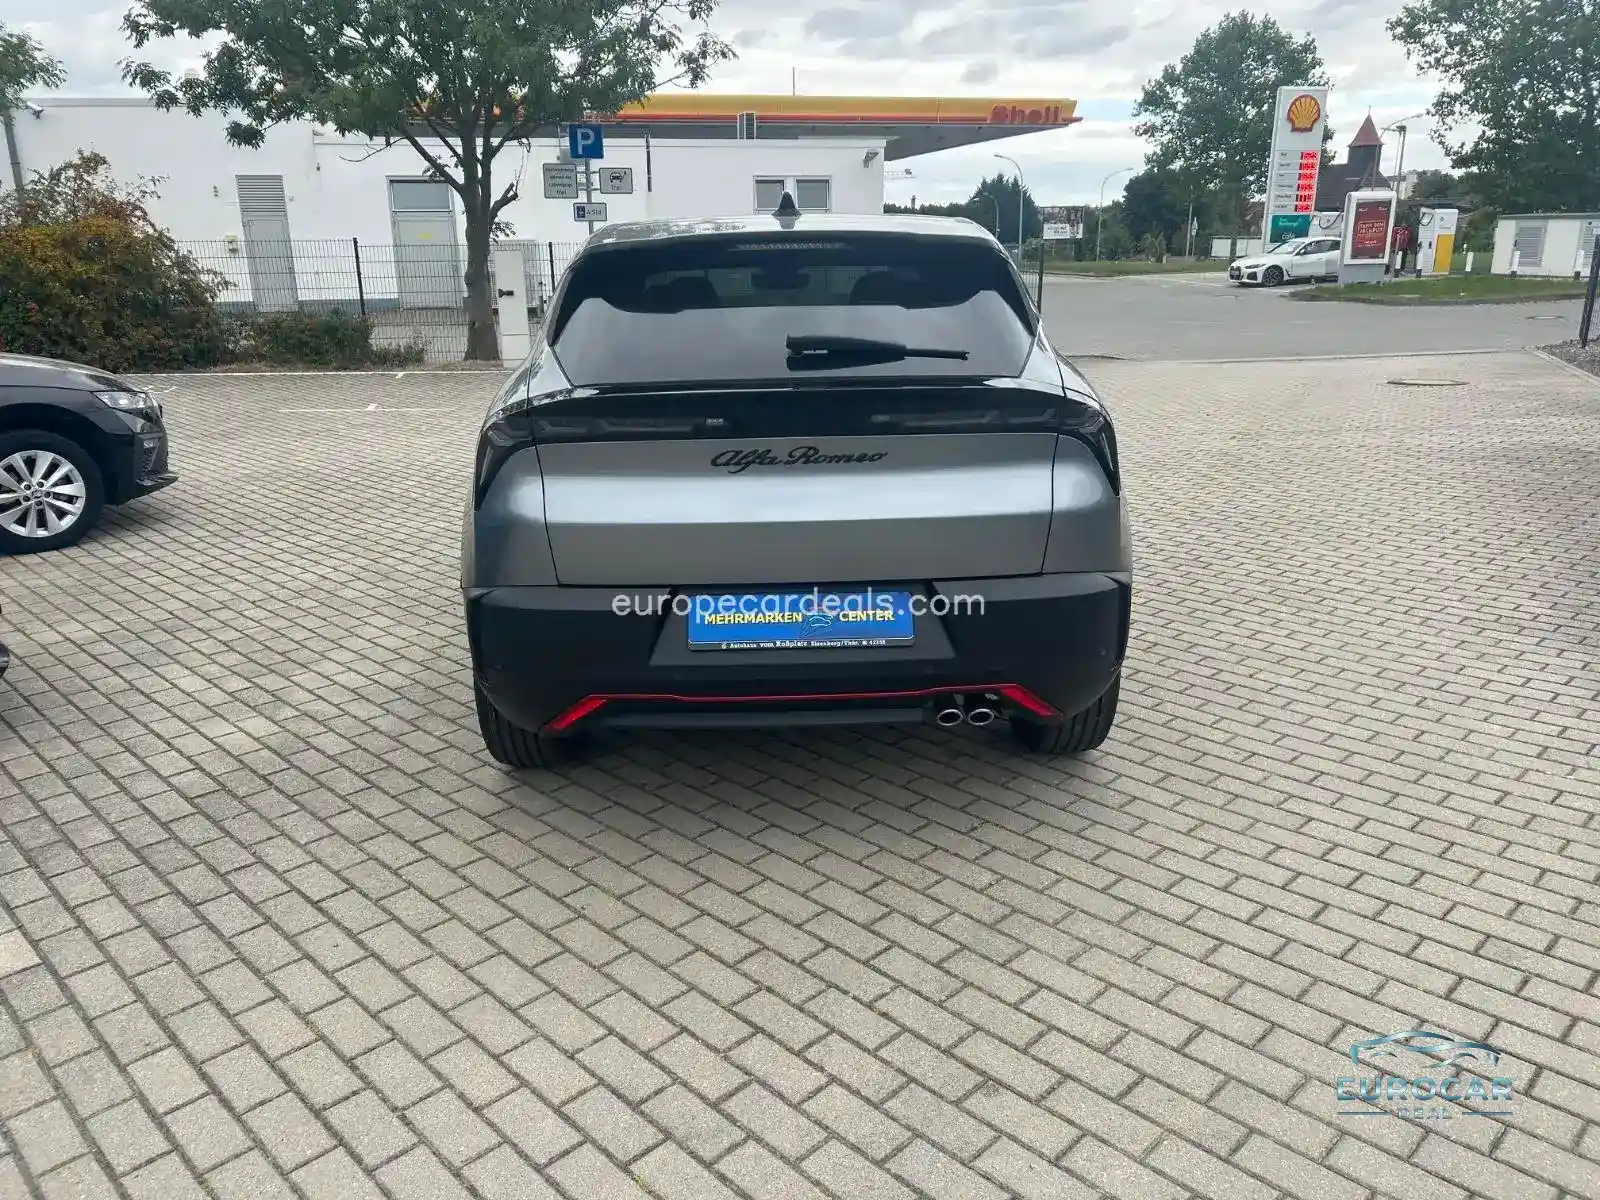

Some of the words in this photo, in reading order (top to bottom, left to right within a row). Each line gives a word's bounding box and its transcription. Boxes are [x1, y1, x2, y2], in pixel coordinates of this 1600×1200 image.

[991, 105, 1062, 123] Shell
[577, 128, 595, 155] P
[710, 449, 784, 474] Alfa
[784, 446, 889, 466] Romeo
[704, 611, 803, 625] MEHRMARKEN
[839, 610, 894, 622] CENTER
